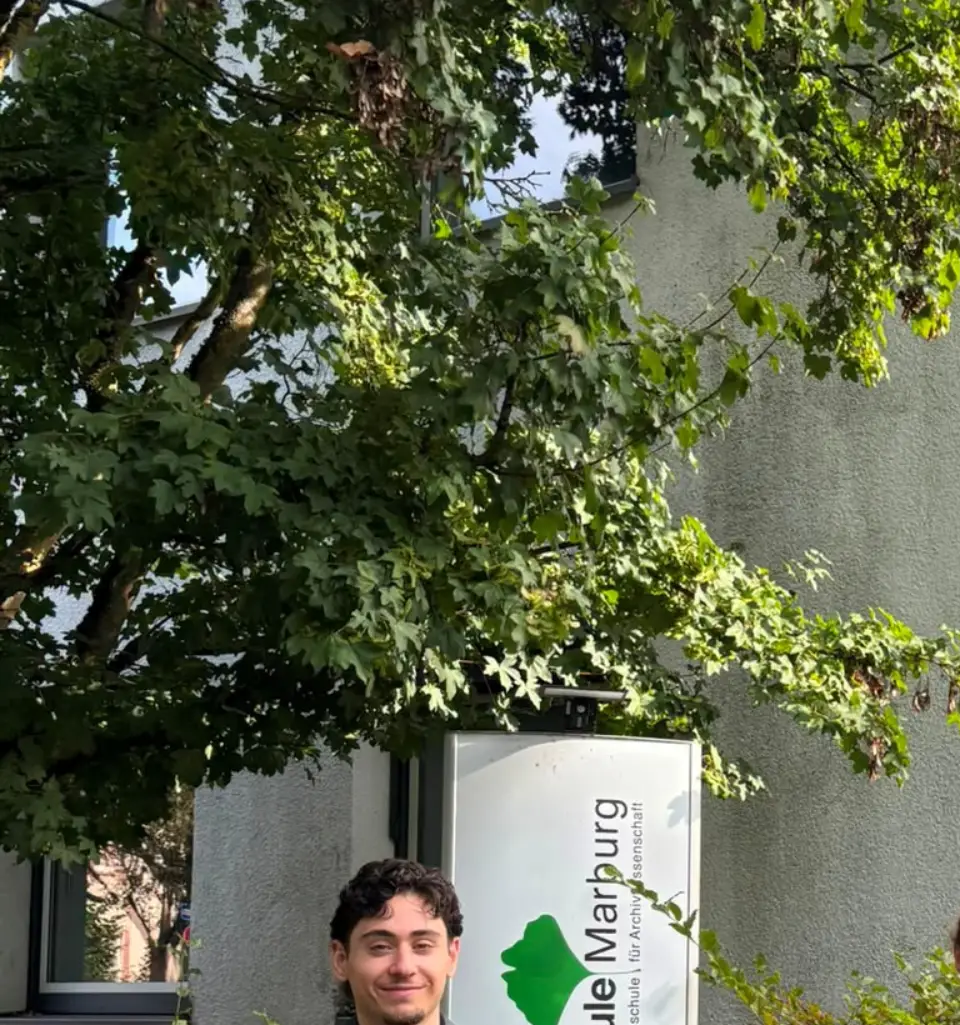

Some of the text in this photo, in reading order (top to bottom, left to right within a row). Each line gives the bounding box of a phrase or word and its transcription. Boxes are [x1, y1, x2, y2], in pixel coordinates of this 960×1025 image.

[584, 798, 628, 962] Marburg
[629, 801, 644, 941] Archivssenschaft
[628, 943, 642, 963] für
